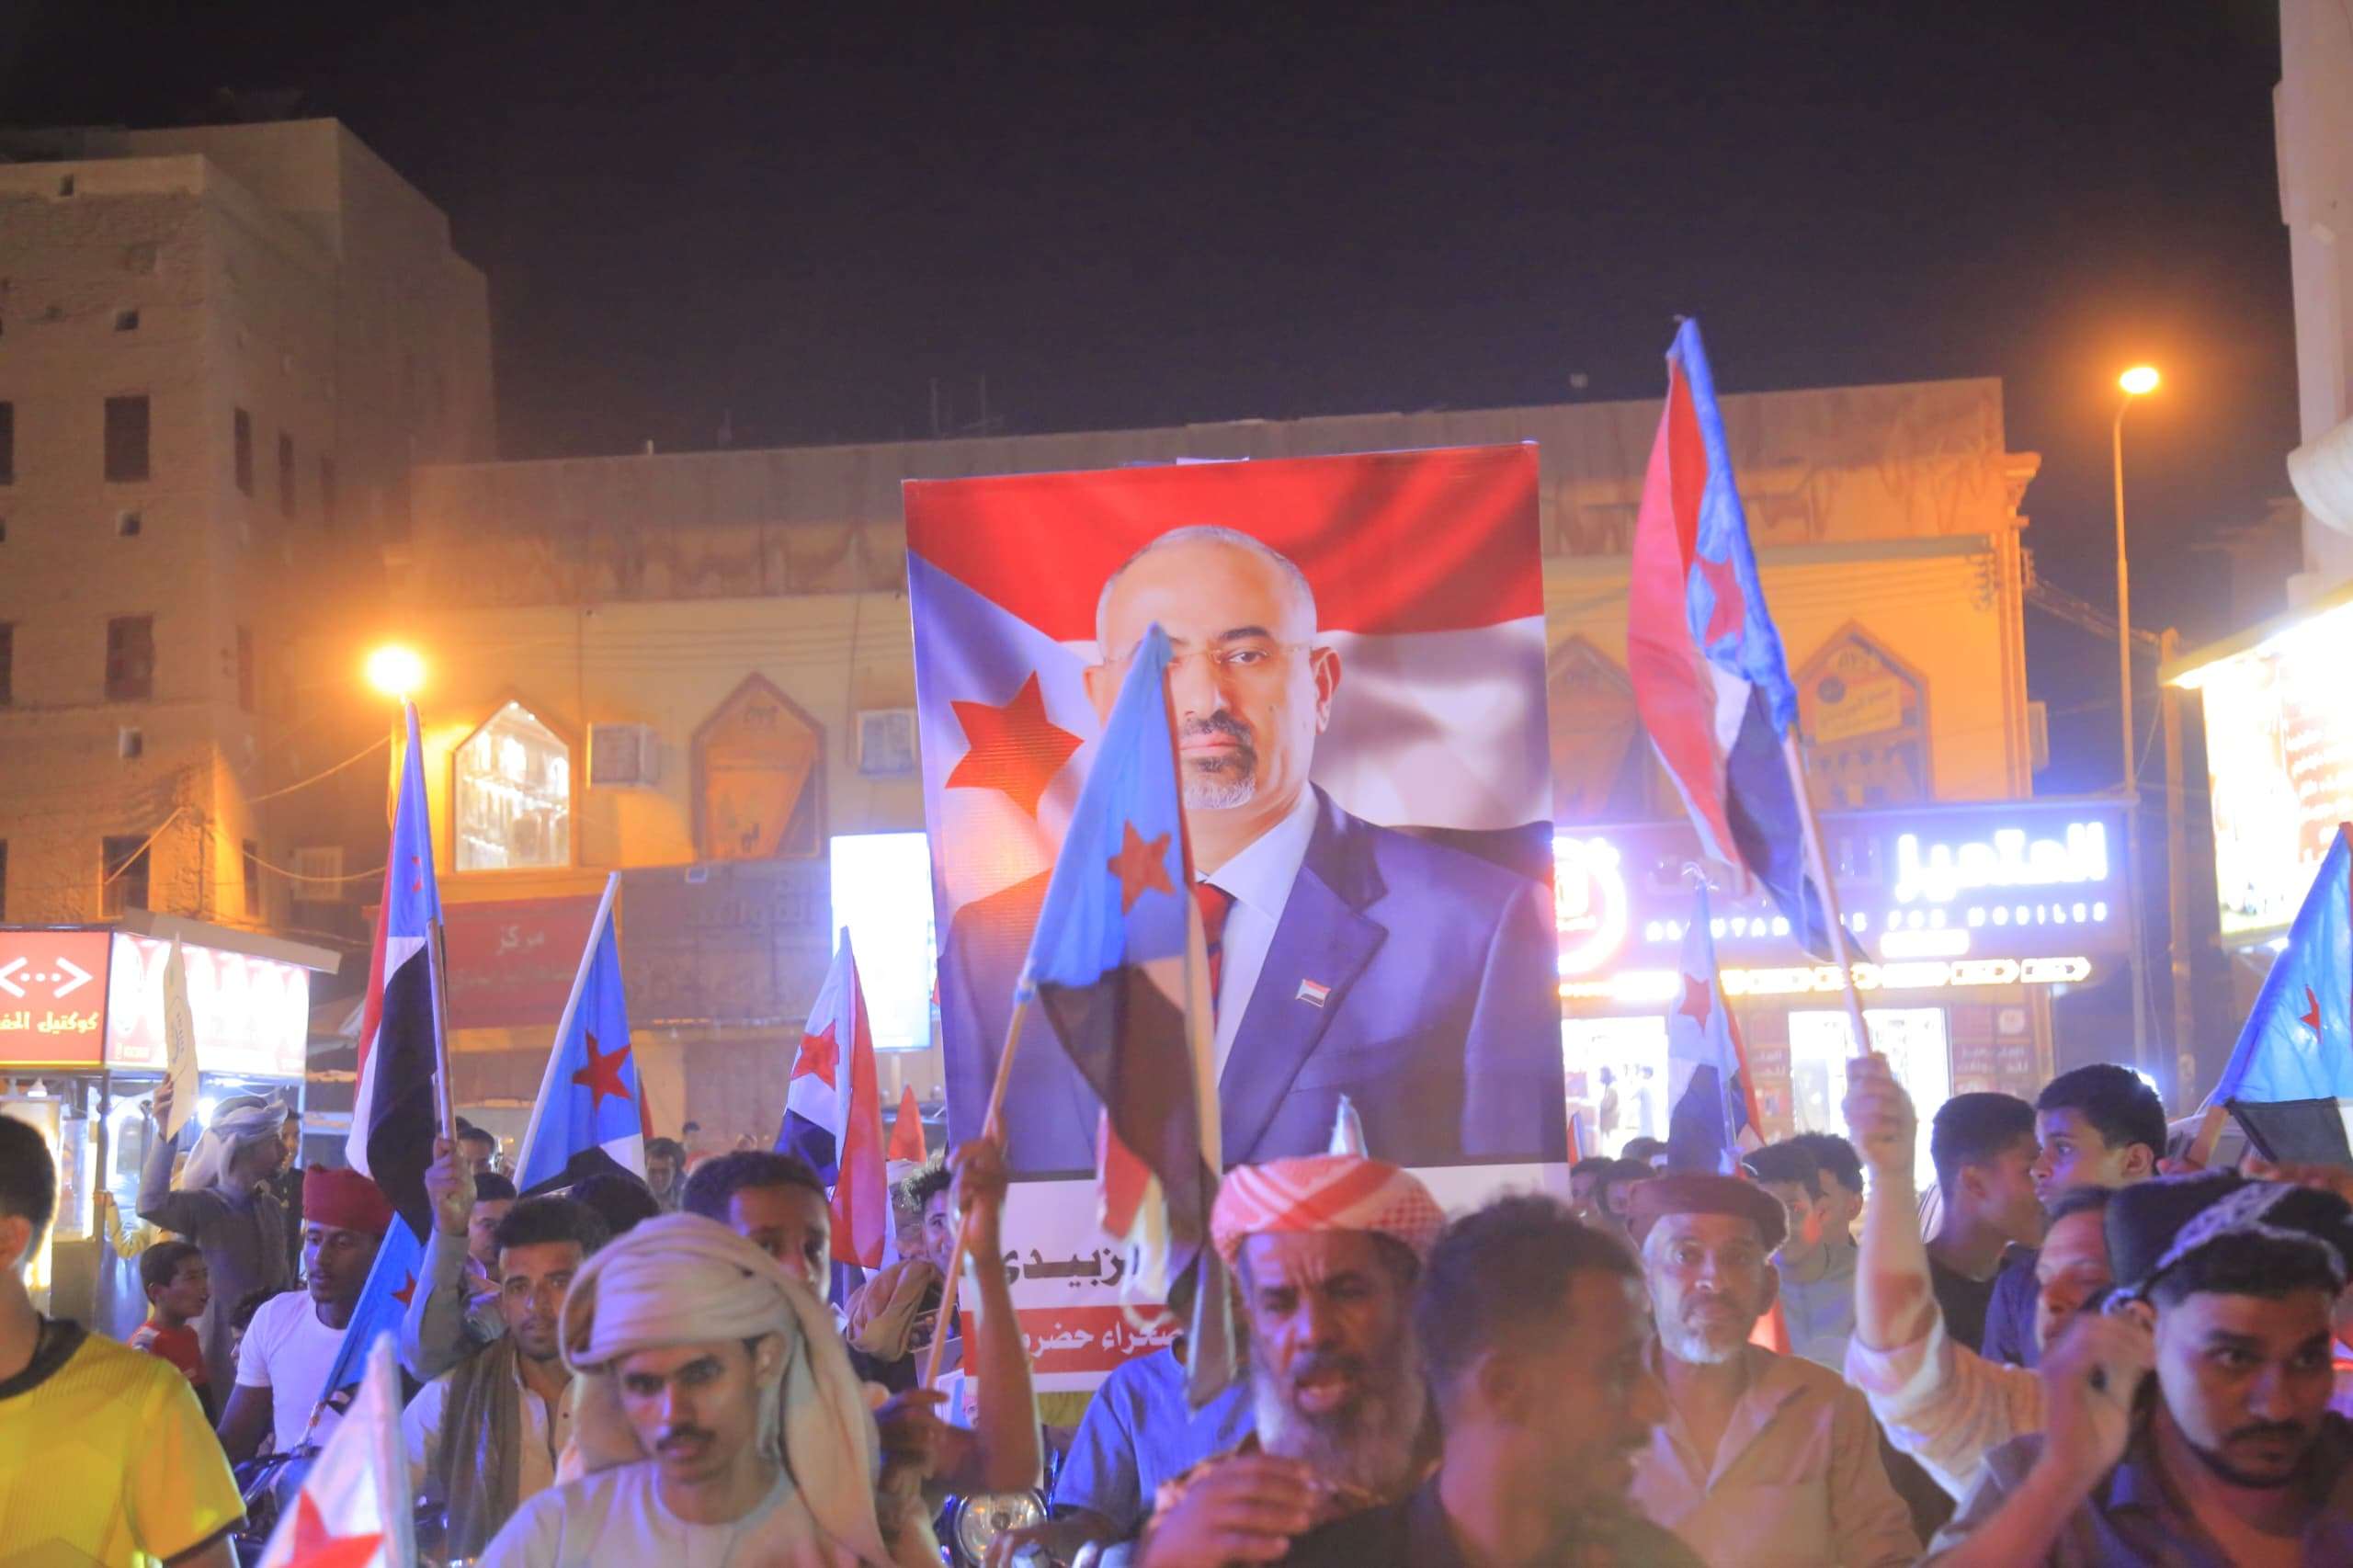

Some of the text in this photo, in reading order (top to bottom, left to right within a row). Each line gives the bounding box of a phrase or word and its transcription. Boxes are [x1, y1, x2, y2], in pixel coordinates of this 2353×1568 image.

[1888, 909, 1947, 930] FOR
[1968, 902, 2107, 926] MOBILES
[37, 1011, 98, 1034] كوكتيل
